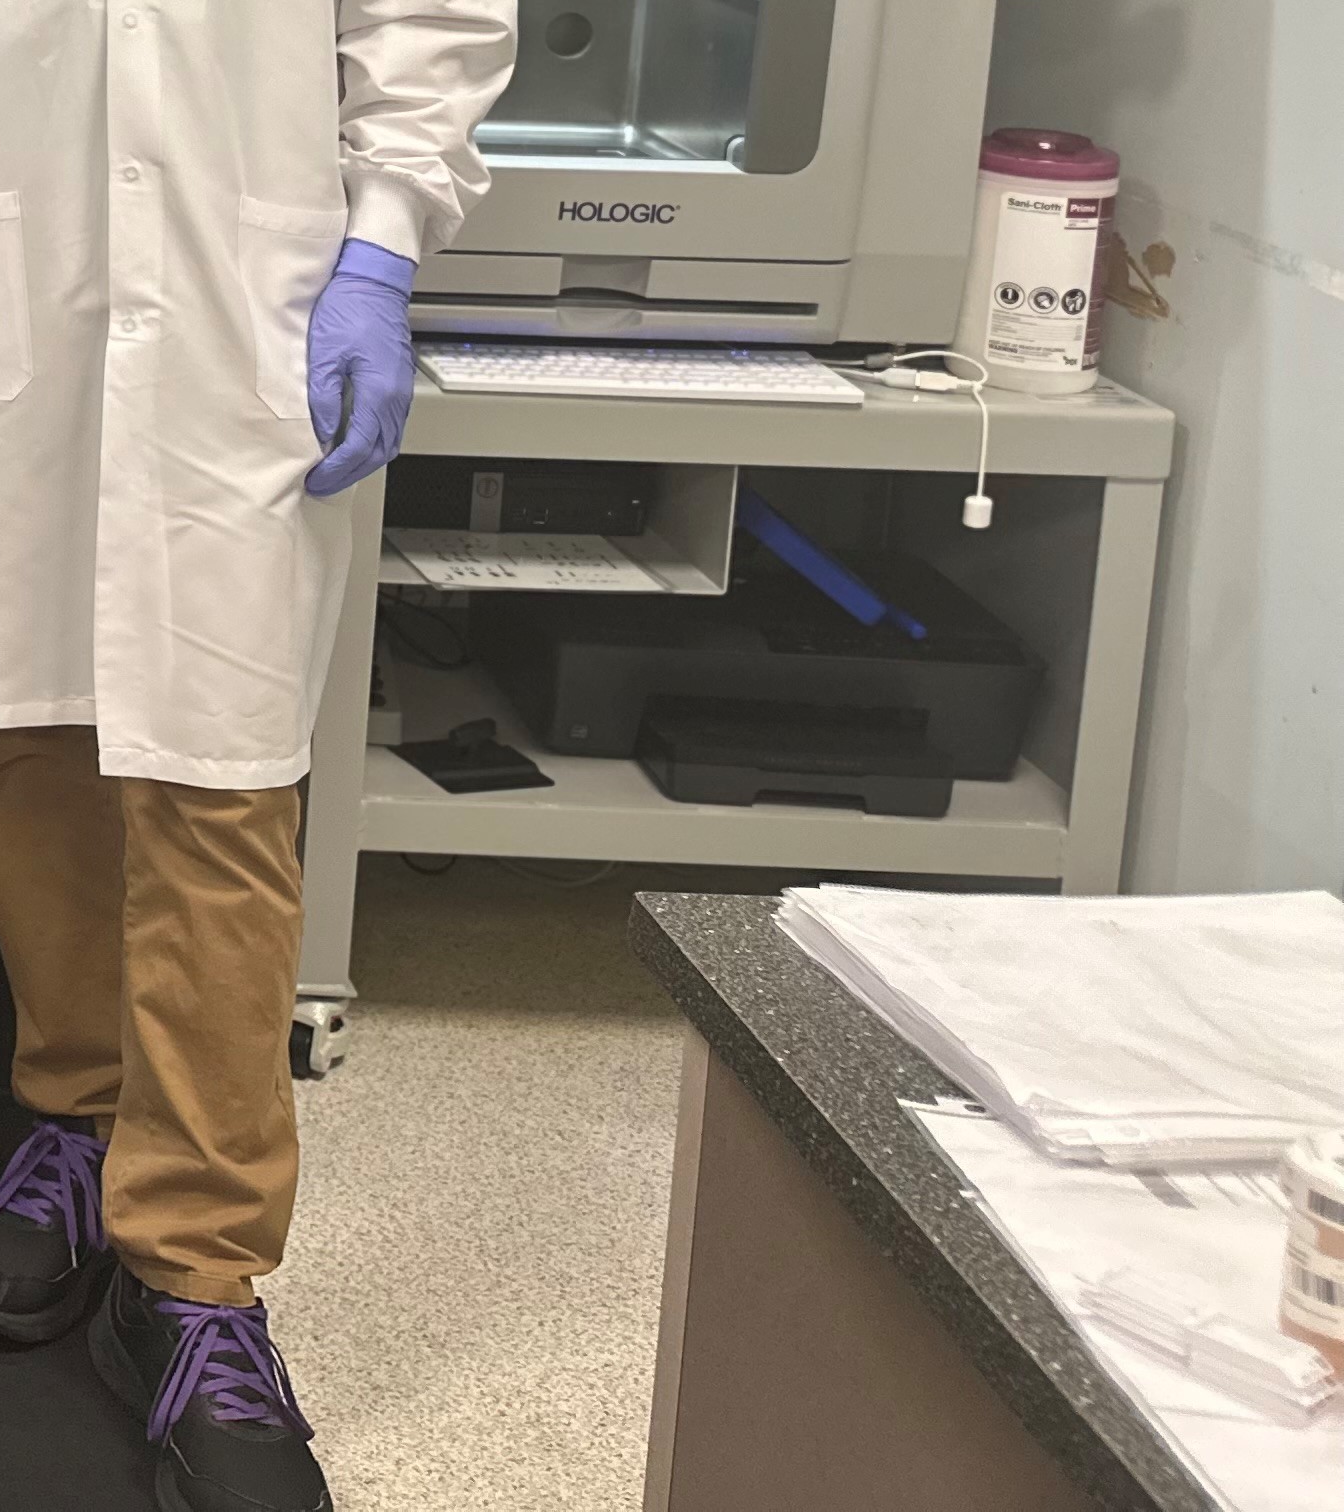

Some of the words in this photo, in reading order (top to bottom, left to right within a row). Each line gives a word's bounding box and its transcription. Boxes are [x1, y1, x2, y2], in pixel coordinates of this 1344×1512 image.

[558, 201, 675, 224] HOLOGIC
[1007, 197, 1062, 211] Sani-Cloth
[1070, 204, 1096, 212] Prime
